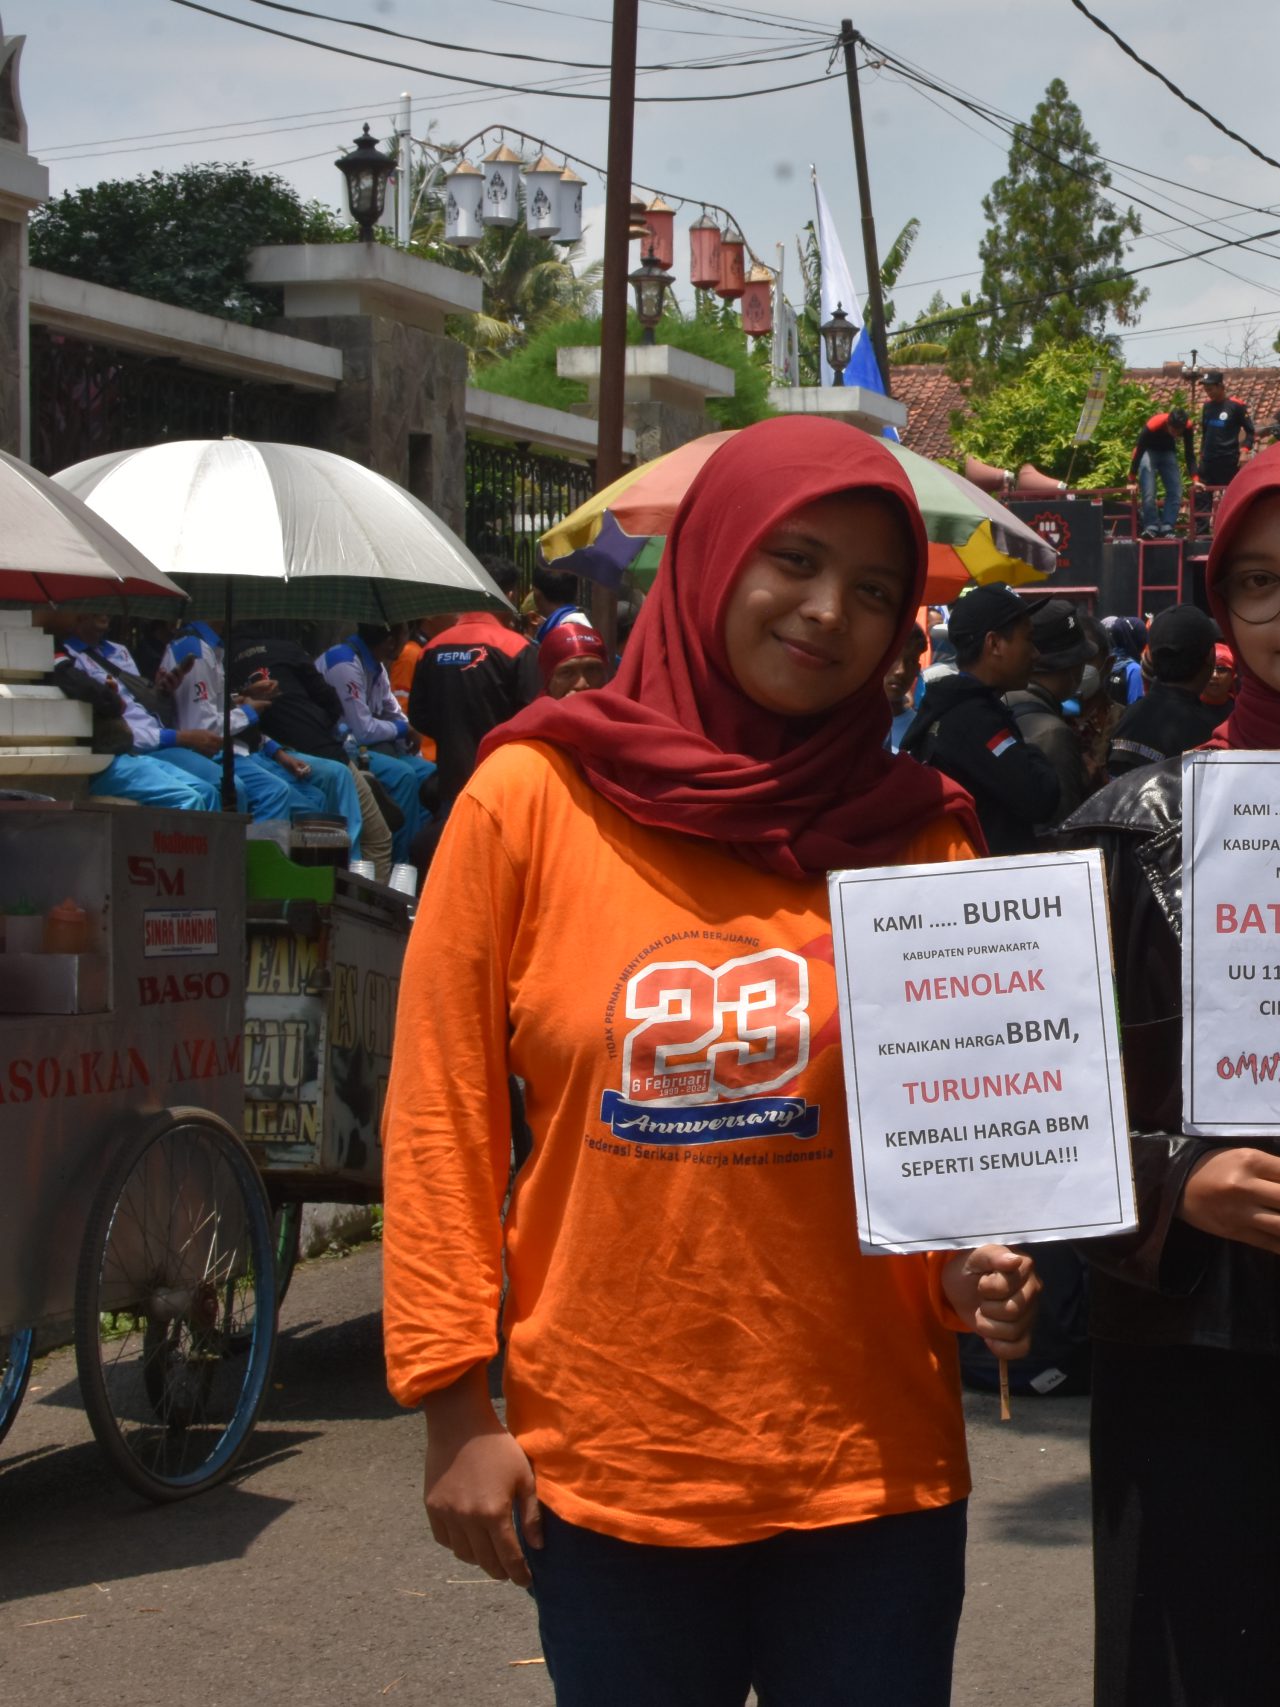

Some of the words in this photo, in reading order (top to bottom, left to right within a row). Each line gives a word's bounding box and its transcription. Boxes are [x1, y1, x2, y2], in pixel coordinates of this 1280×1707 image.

[1234, 804, 1269, 815] KAMI
[127, 856, 186, 896] SM
[874, 915, 922, 932] KAMI
[964, 896, 1061, 924] BURUH
[663, 930, 700, 945] DALAM
[702, 930, 760, 947] BERJUANG
[903, 948, 964, 961] KABUPATEN
[967, 942, 1039, 955] PURWAKARTA
[618, 939, 664, 982] MENYERAH
[1229, 965, 1255, 980] UU
[138, 972, 230, 1006] BASO
[905, 969, 1045, 1002] MENOLAK
[604, 983, 623, 1024] PERNAH
[604, 1027, 617, 1060] TIDAK
[622, 948, 810, 1109] 23
[879, 1039, 950, 1055] KENAIKAN
[955, 1034, 1005, 1049] HARGA
[1007, 1018, 1079, 1044] BBM,
[631, 1079, 641, 1092] 6
[645, 1071, 708, 1091] Februari
[902, 1070, 1062, 1104] TURUNKAN
[886, 1126, 967, 1147] KEMBALI
[974, 1120, 1040, 1139] HARGA
[1046, 1115, 1088, 1133] BBM
[585, 1134, 631, 1157] Federasi
[634, 1145, 679, 1161] Serikat
[683, 1150, 729, 1168] Pekerja
[732, 1152, 769, 1166] Metal
[772, 1149, 834, 1165] Indonesia
[902, 1157, 973, 1177] SEPERTI
[980, 1146, 1077, 1170] SEMULA!!!
